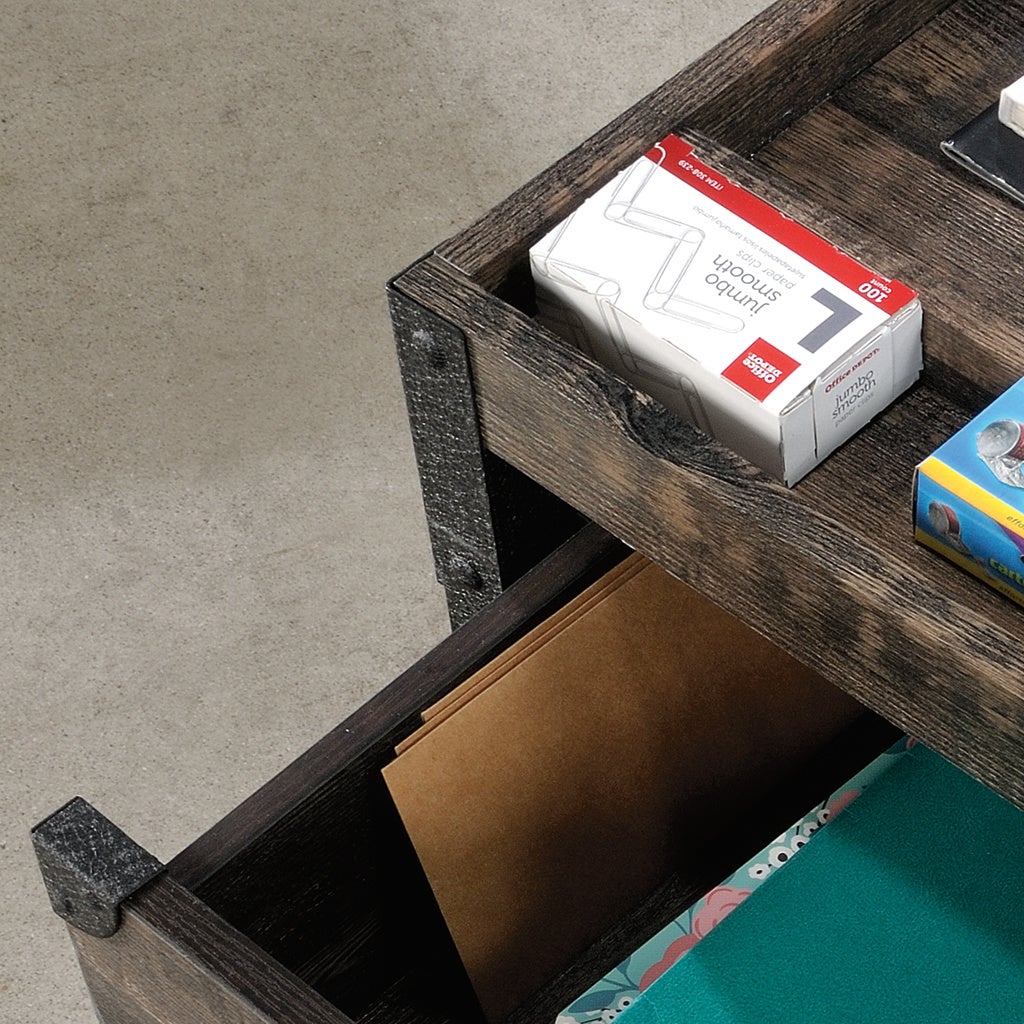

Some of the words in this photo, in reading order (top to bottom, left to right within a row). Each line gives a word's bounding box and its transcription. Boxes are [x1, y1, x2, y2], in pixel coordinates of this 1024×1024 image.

[705, 175, 724, 191] ITEM
[735, 248, 763, 271] clips
[712, 253, 783, 303] smooth
[761, 262, 797, 290] paper
[869, 278, 892, 294] count
[704, 272, 770, 318] jumbo
[858, 282, 889, 304] 100
[742, 358, 777, 384] Office
[747, 353, 783, 377] DEPOT
[824, 369, 852, 394] Office
[835, 369, 875, 407] jumbo
[831, 378, 877, 420] smooth
